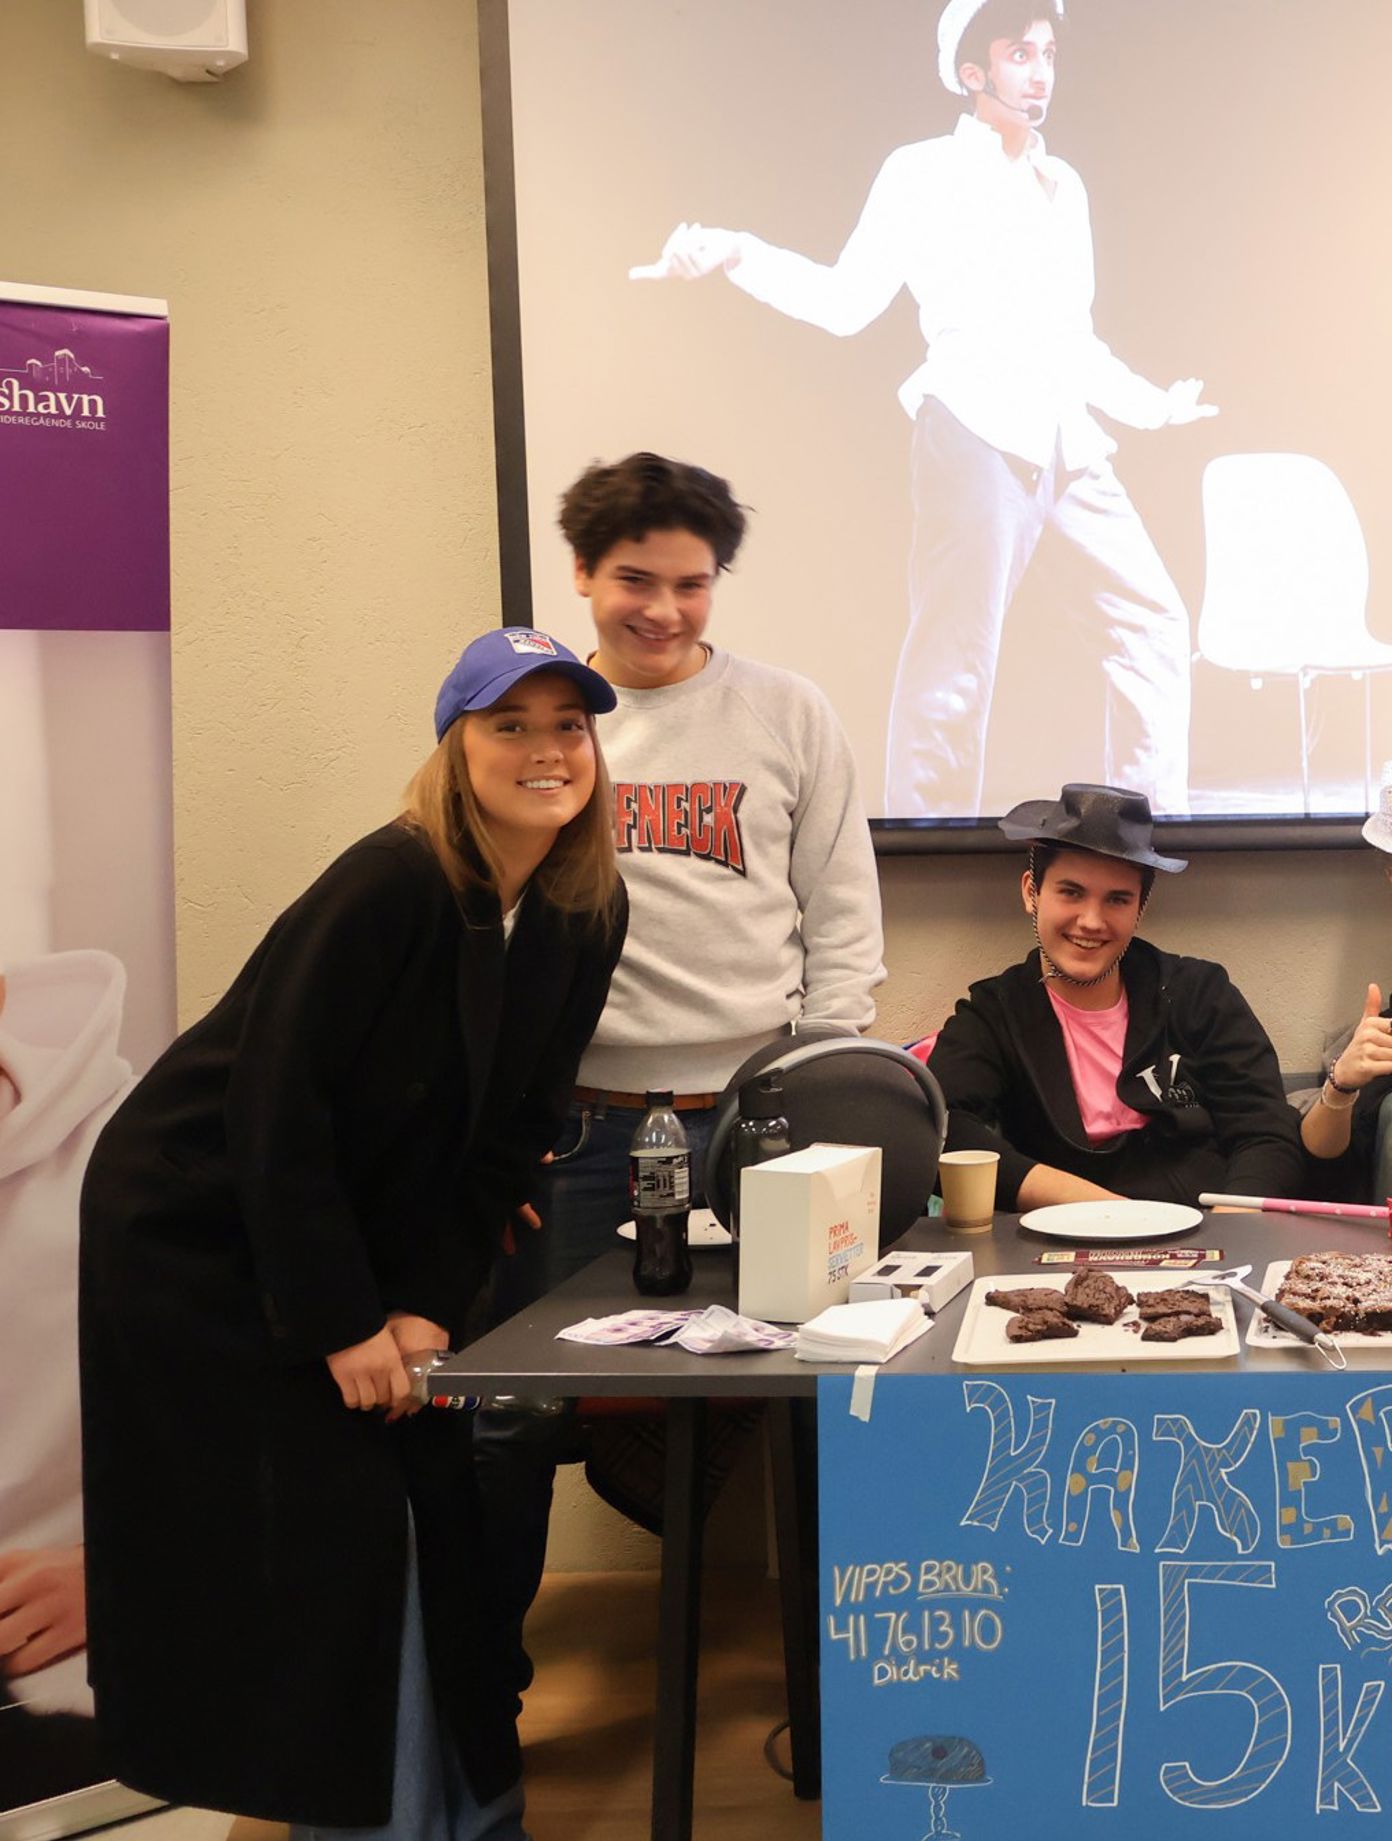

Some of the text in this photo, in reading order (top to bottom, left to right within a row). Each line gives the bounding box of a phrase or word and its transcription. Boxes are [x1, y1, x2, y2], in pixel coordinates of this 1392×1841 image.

[75, 420, 106, 431] SKOLE
[613, 782, 748, 878] FNECK
[833, 1558, 1013, 1607] VIPPS BRUR:
[872, 1656, 961, 1687] Didrik
[1083, 1561, 1293, 1809] 15
